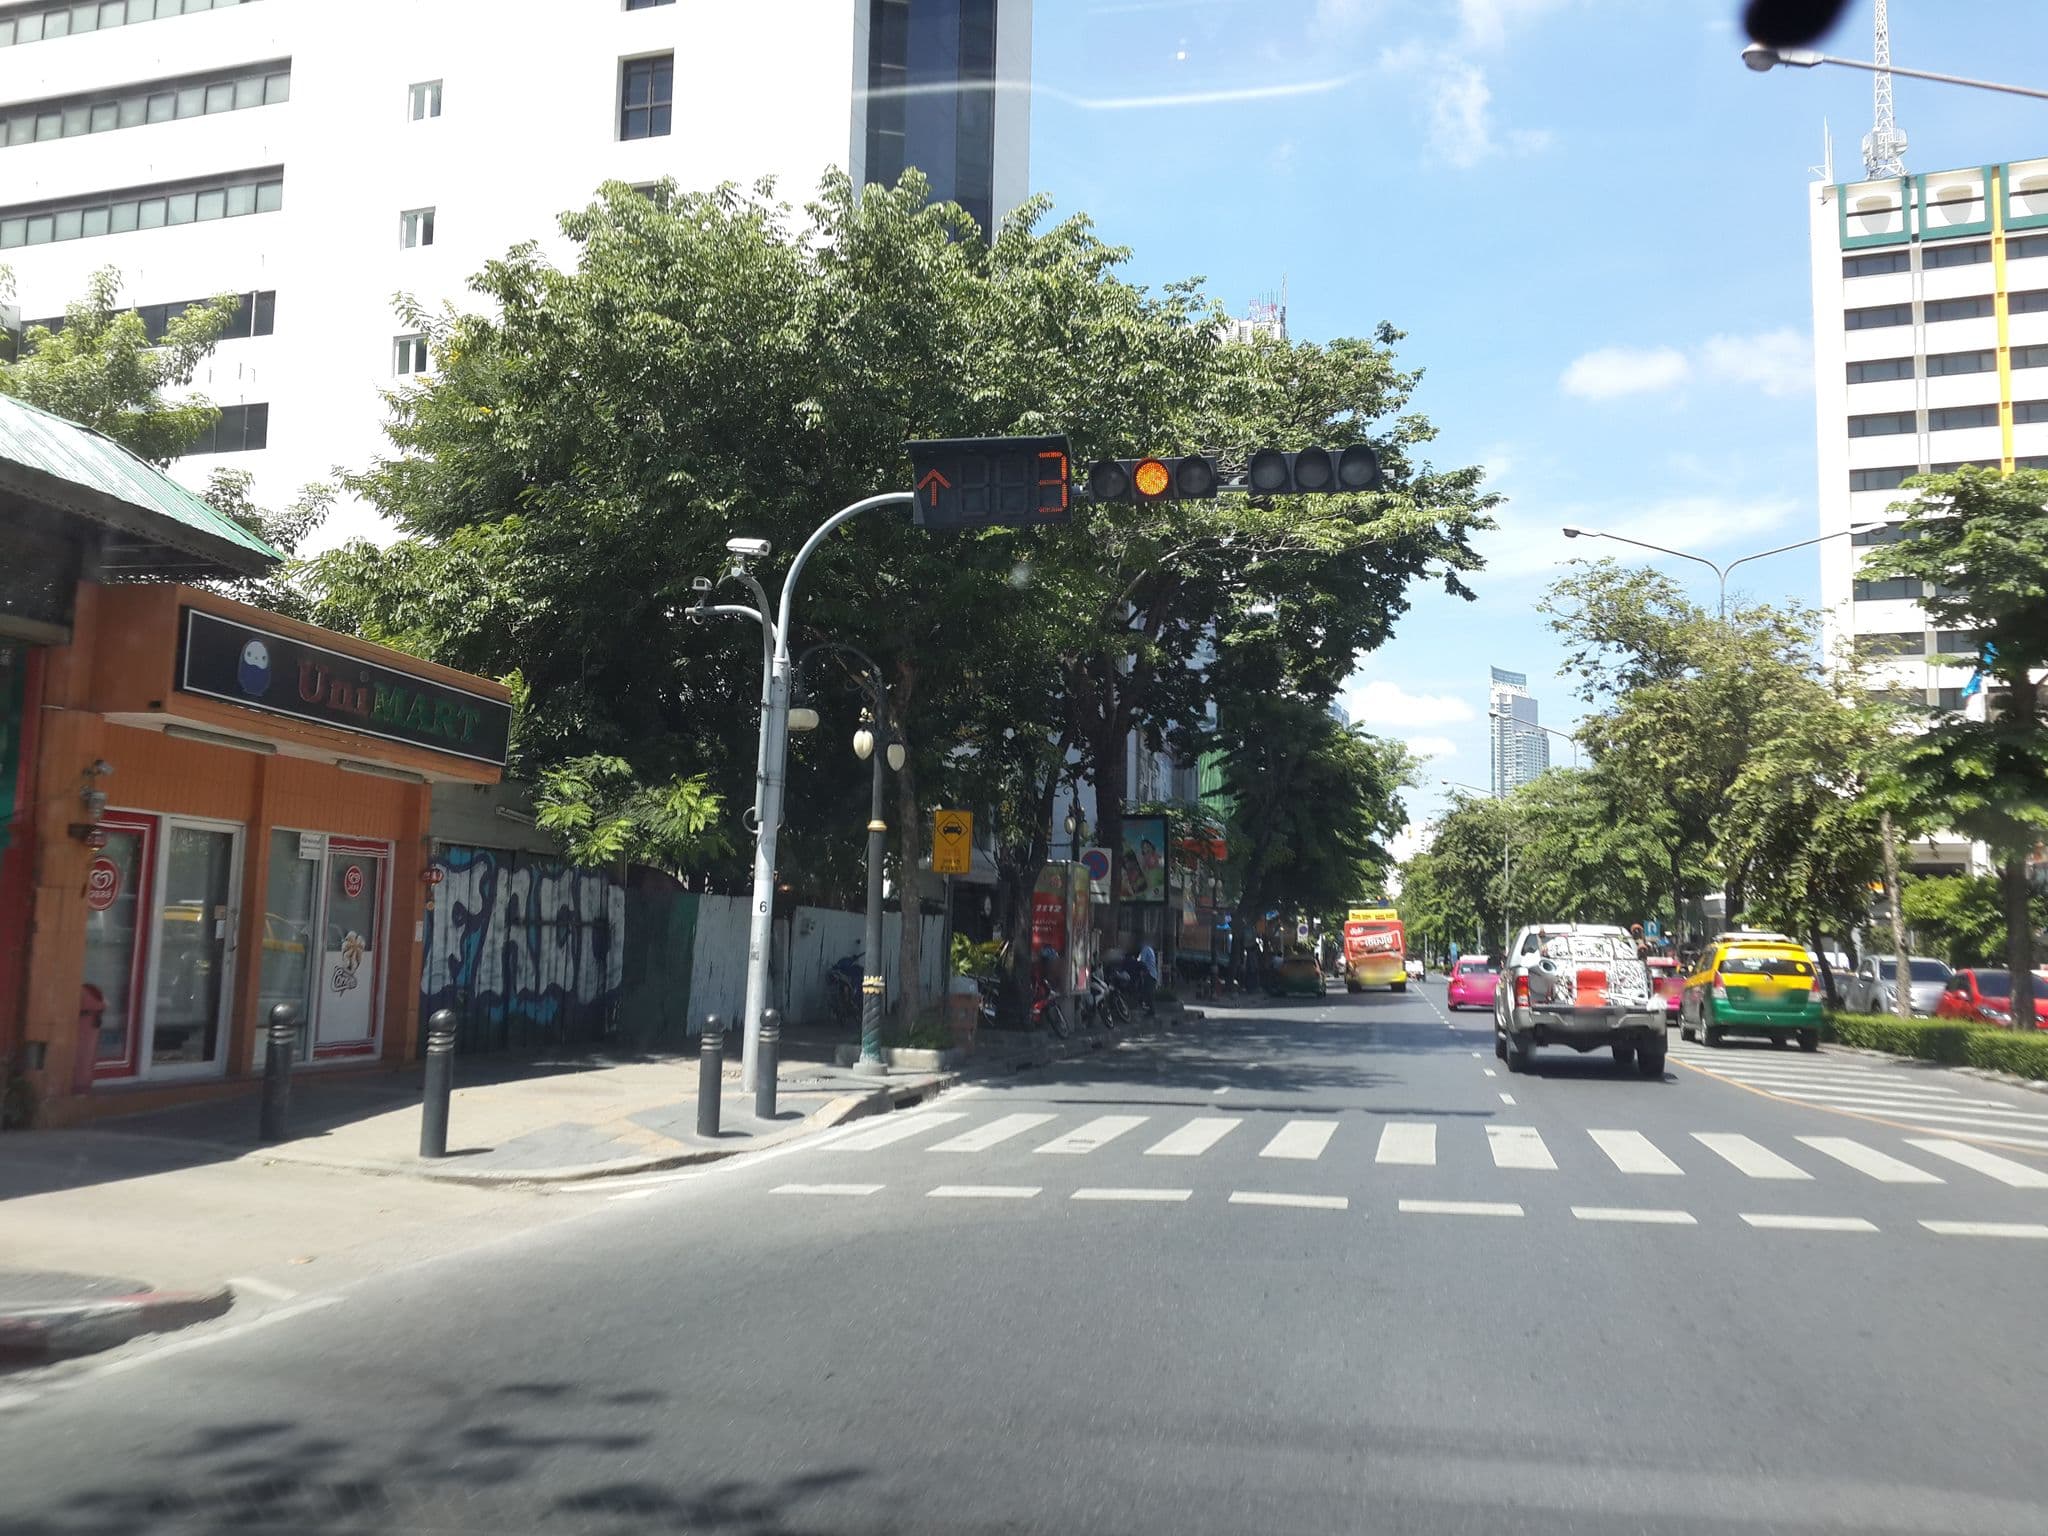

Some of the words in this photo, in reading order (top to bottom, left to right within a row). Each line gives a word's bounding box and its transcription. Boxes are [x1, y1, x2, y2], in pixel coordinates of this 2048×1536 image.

[1039, 452, 1068, 513] 3
[298, 661, 481, 744] UniMART
[759, 900, 768, 913] 6
